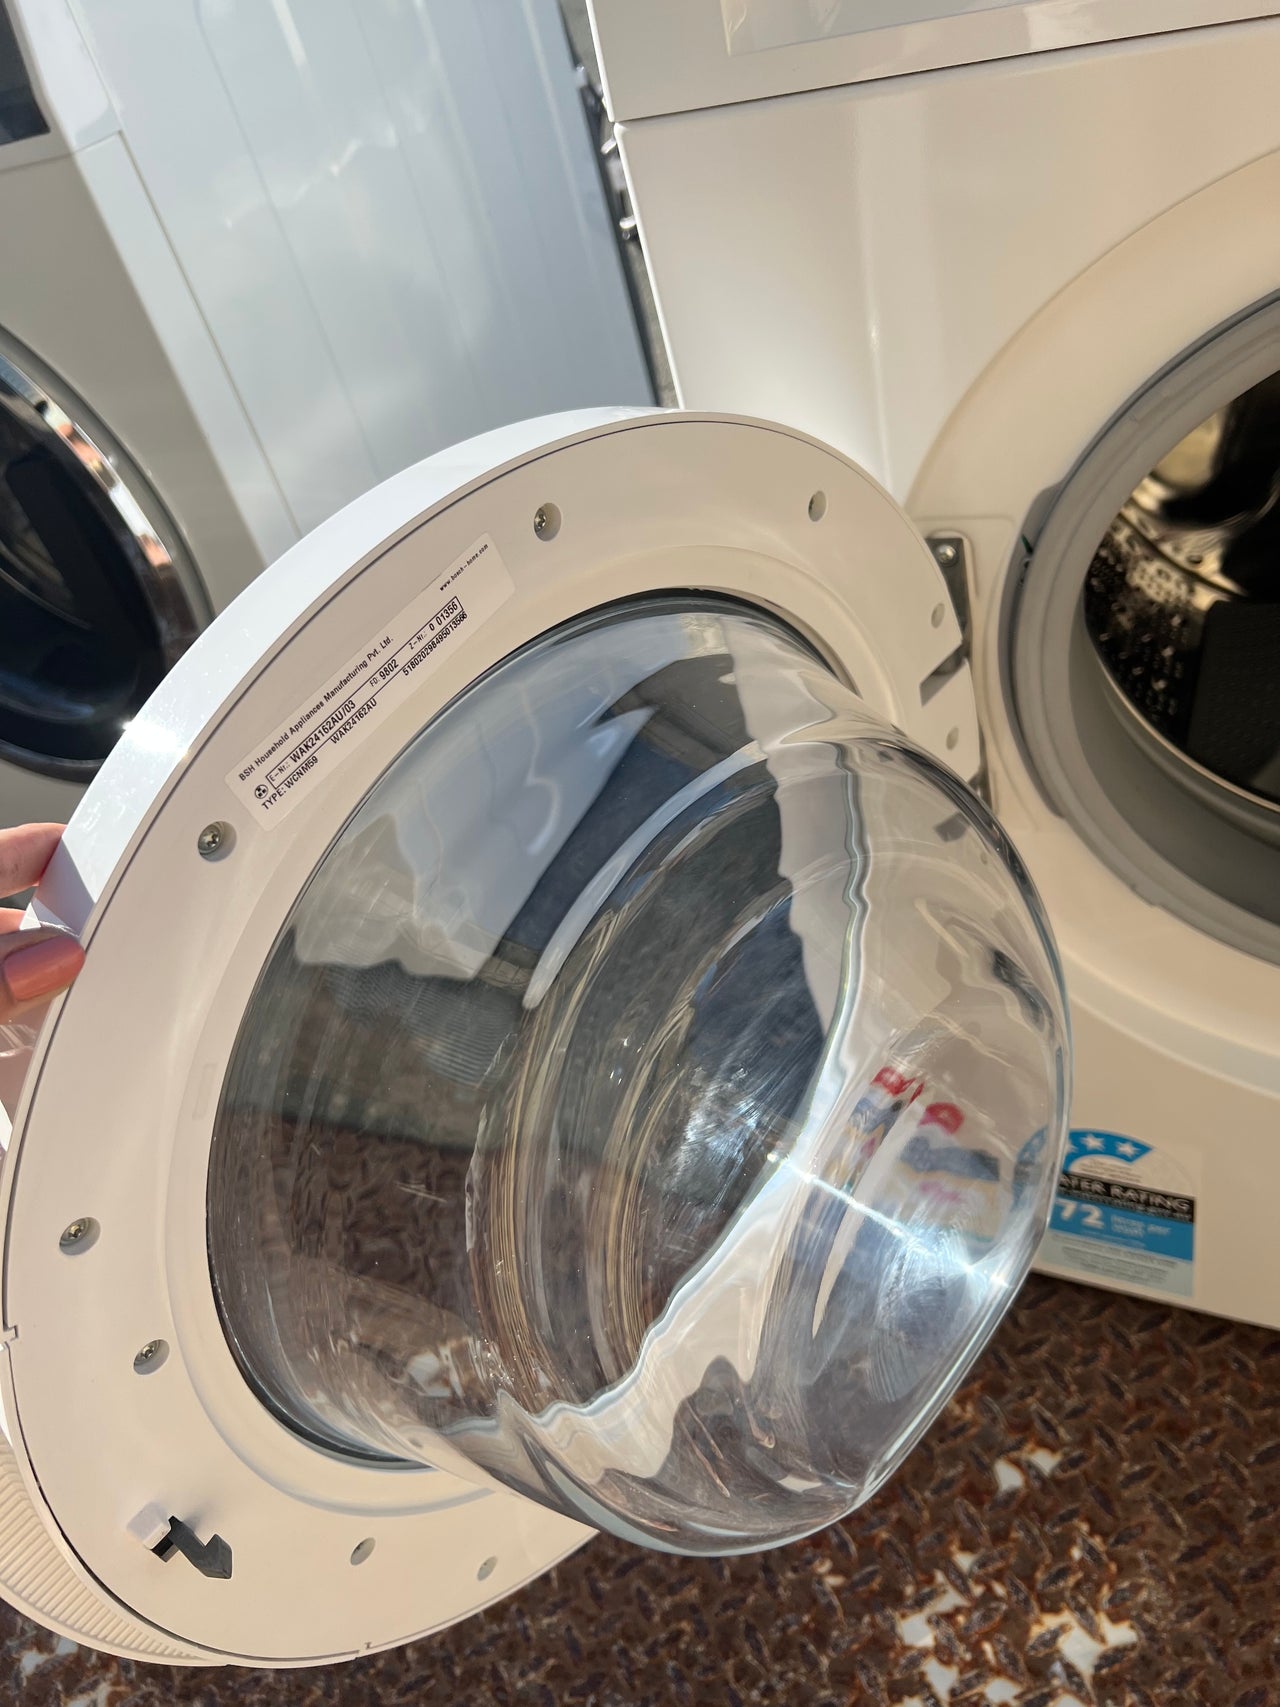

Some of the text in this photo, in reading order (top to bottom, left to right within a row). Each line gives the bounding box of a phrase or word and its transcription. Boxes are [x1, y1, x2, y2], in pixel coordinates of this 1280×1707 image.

[239, 637, 394, 781] BSH Household Appliances Manufacturing Pvt. Ltd.
[290, 700, 356, 764] WAK24162AU/03
[379, 659, 399, 680] 9802
[436, 601, 458, 625] 01356
[261, 786, 286, 810] TYPE:
[285, 756, 319, 789] WCNM59
[331, 699, 378, 745] WAK24162AU
[1055, 1199, 1104, 1228] 72
[1059, 1174, 1107, 1194] ATER
[1110, 1185, 1191, 1212] RATING
